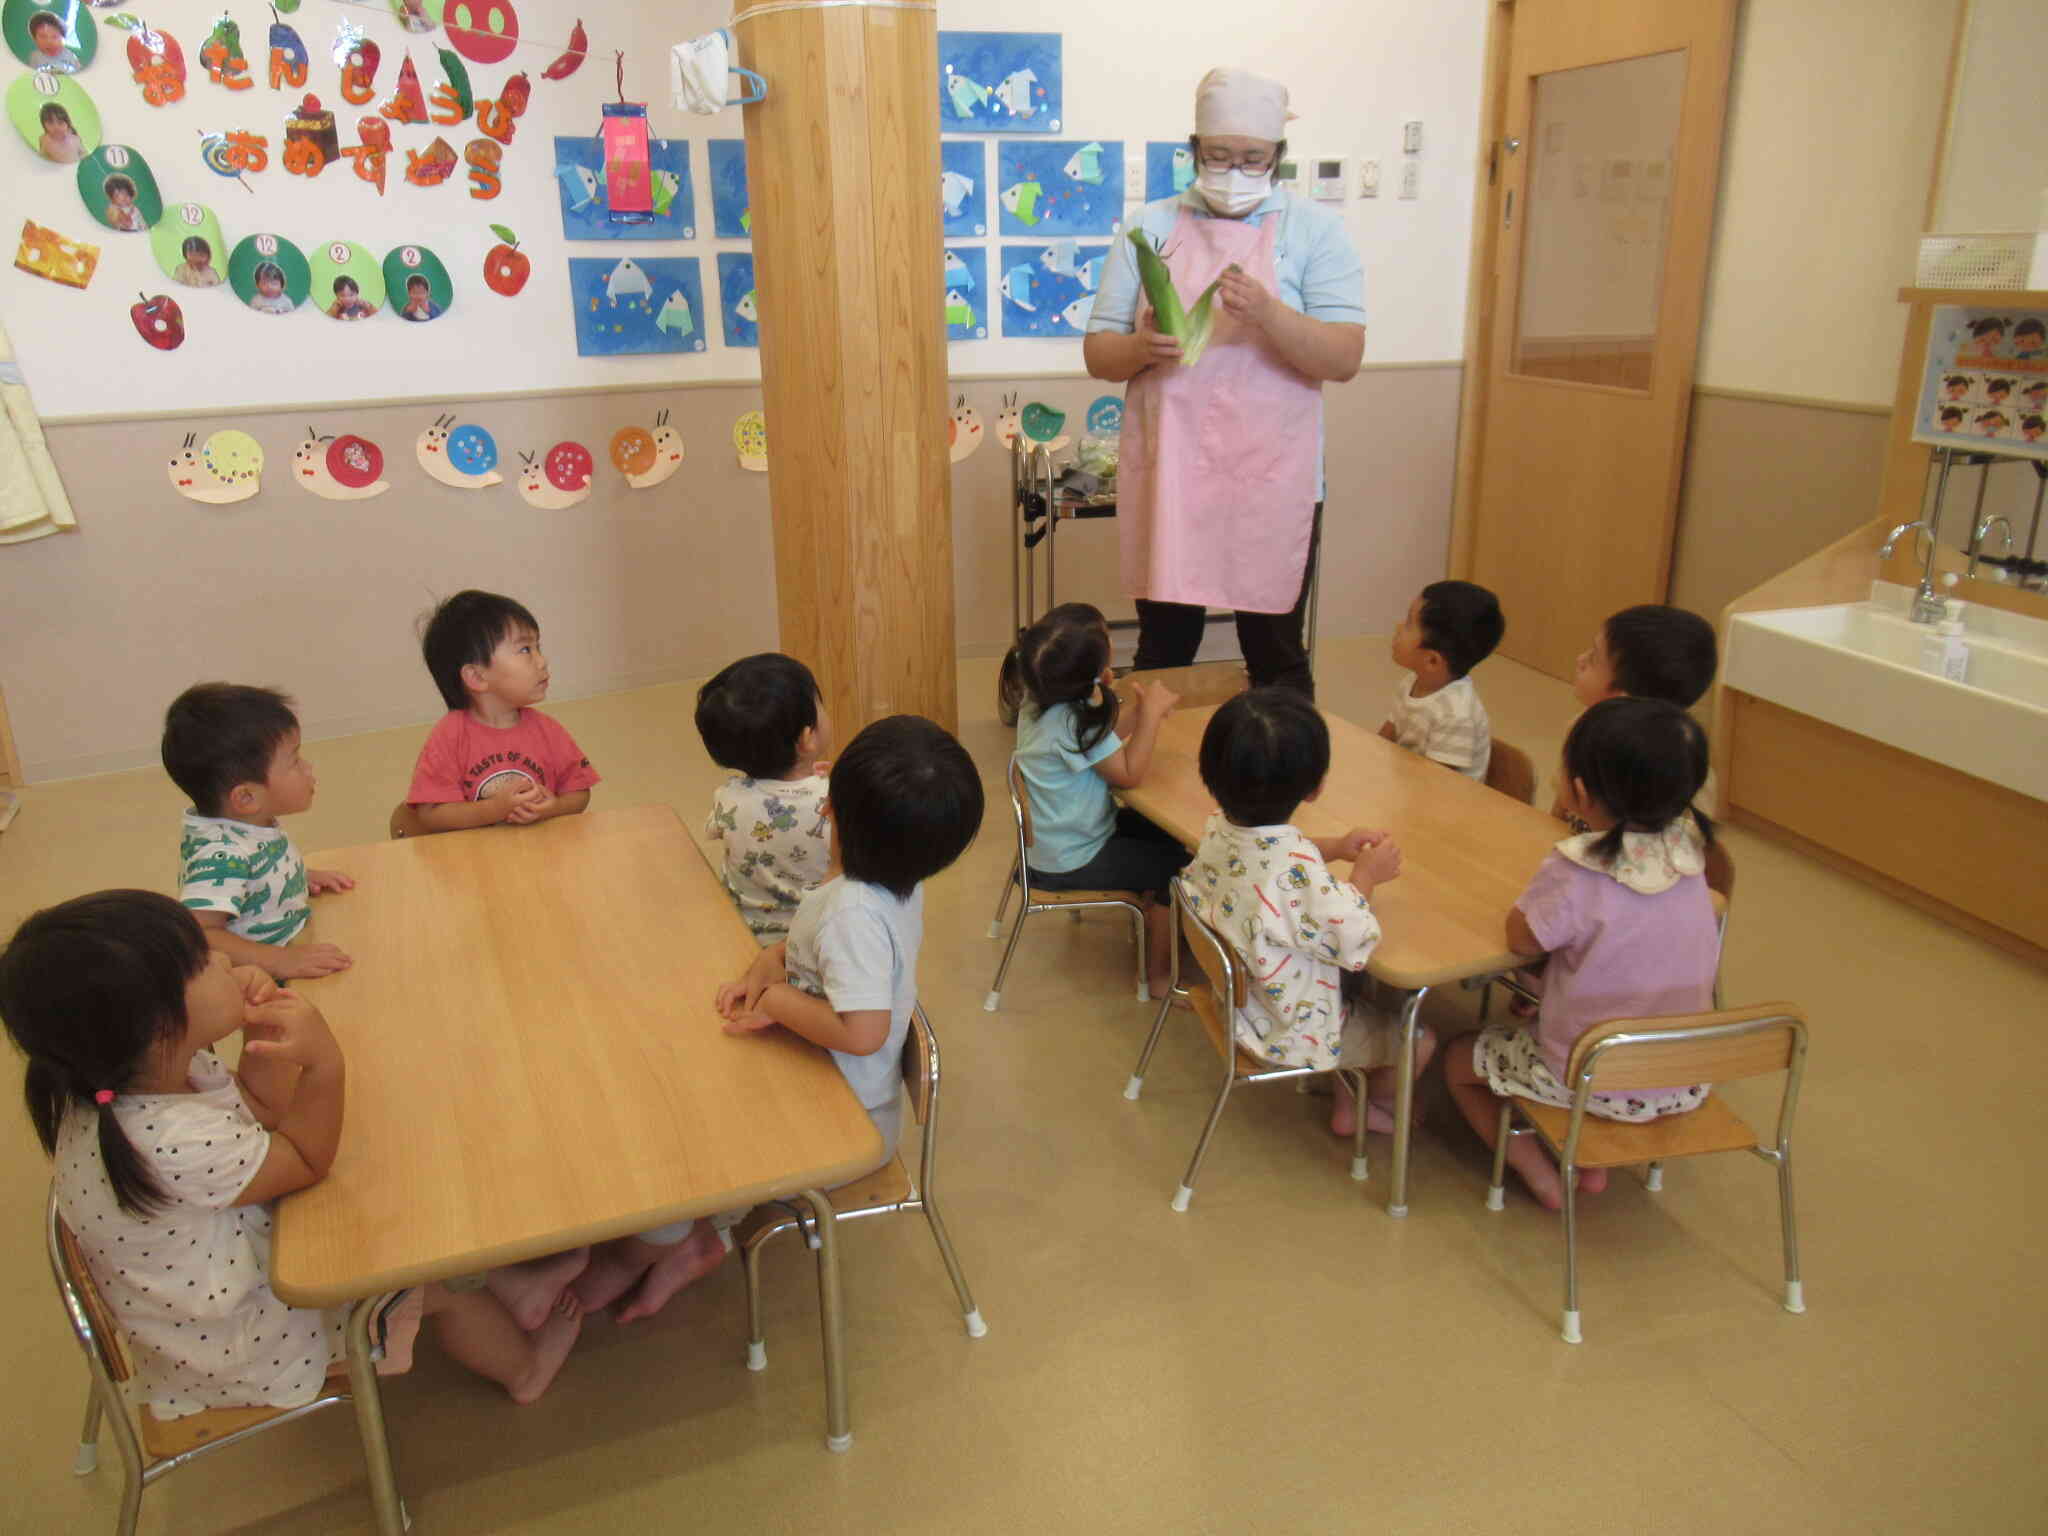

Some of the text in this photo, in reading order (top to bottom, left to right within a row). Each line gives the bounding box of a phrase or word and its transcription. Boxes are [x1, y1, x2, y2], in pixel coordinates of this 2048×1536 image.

[224, 128, 502, 200] おめでとう
